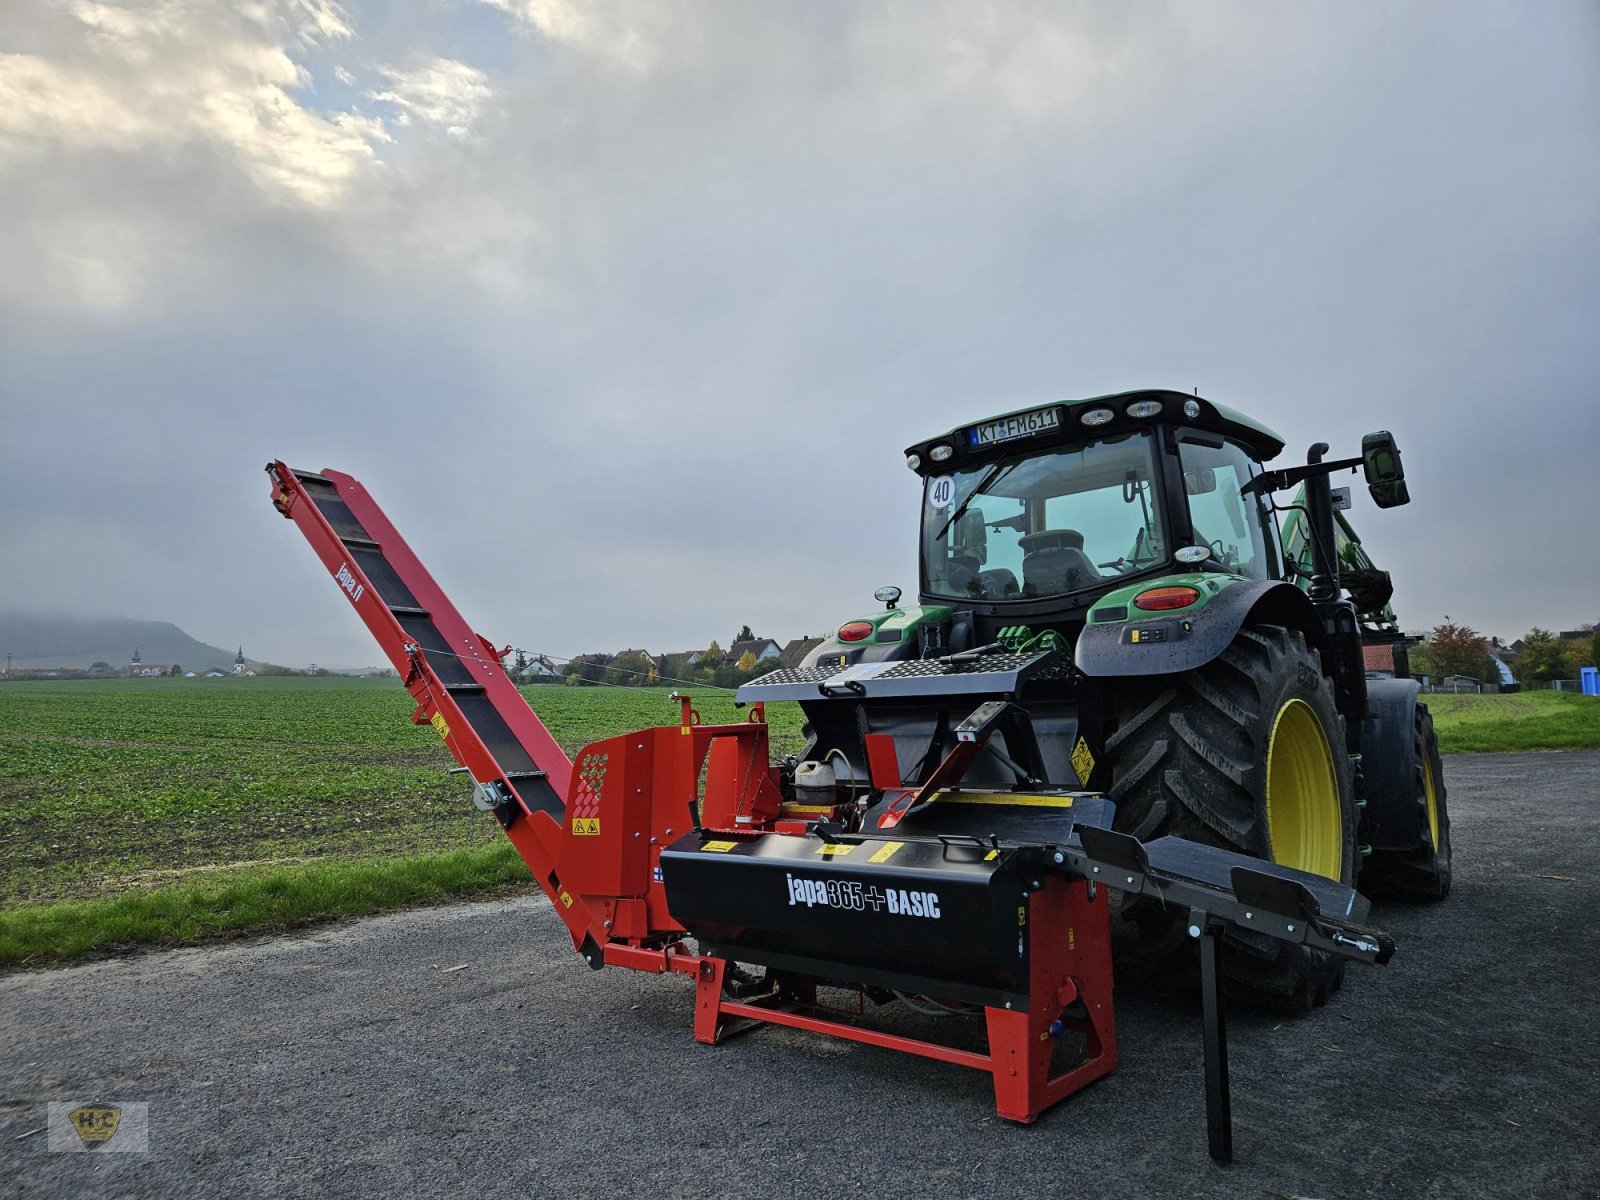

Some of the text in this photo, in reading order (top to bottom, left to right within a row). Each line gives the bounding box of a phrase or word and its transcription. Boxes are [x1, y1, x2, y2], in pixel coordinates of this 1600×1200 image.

[980, 424, 997, 442] KT
[1007, 411, 1056, 436] FM611
[934, 481, 949, 502] 40
[335, 561, 364, 602] japa.fi
